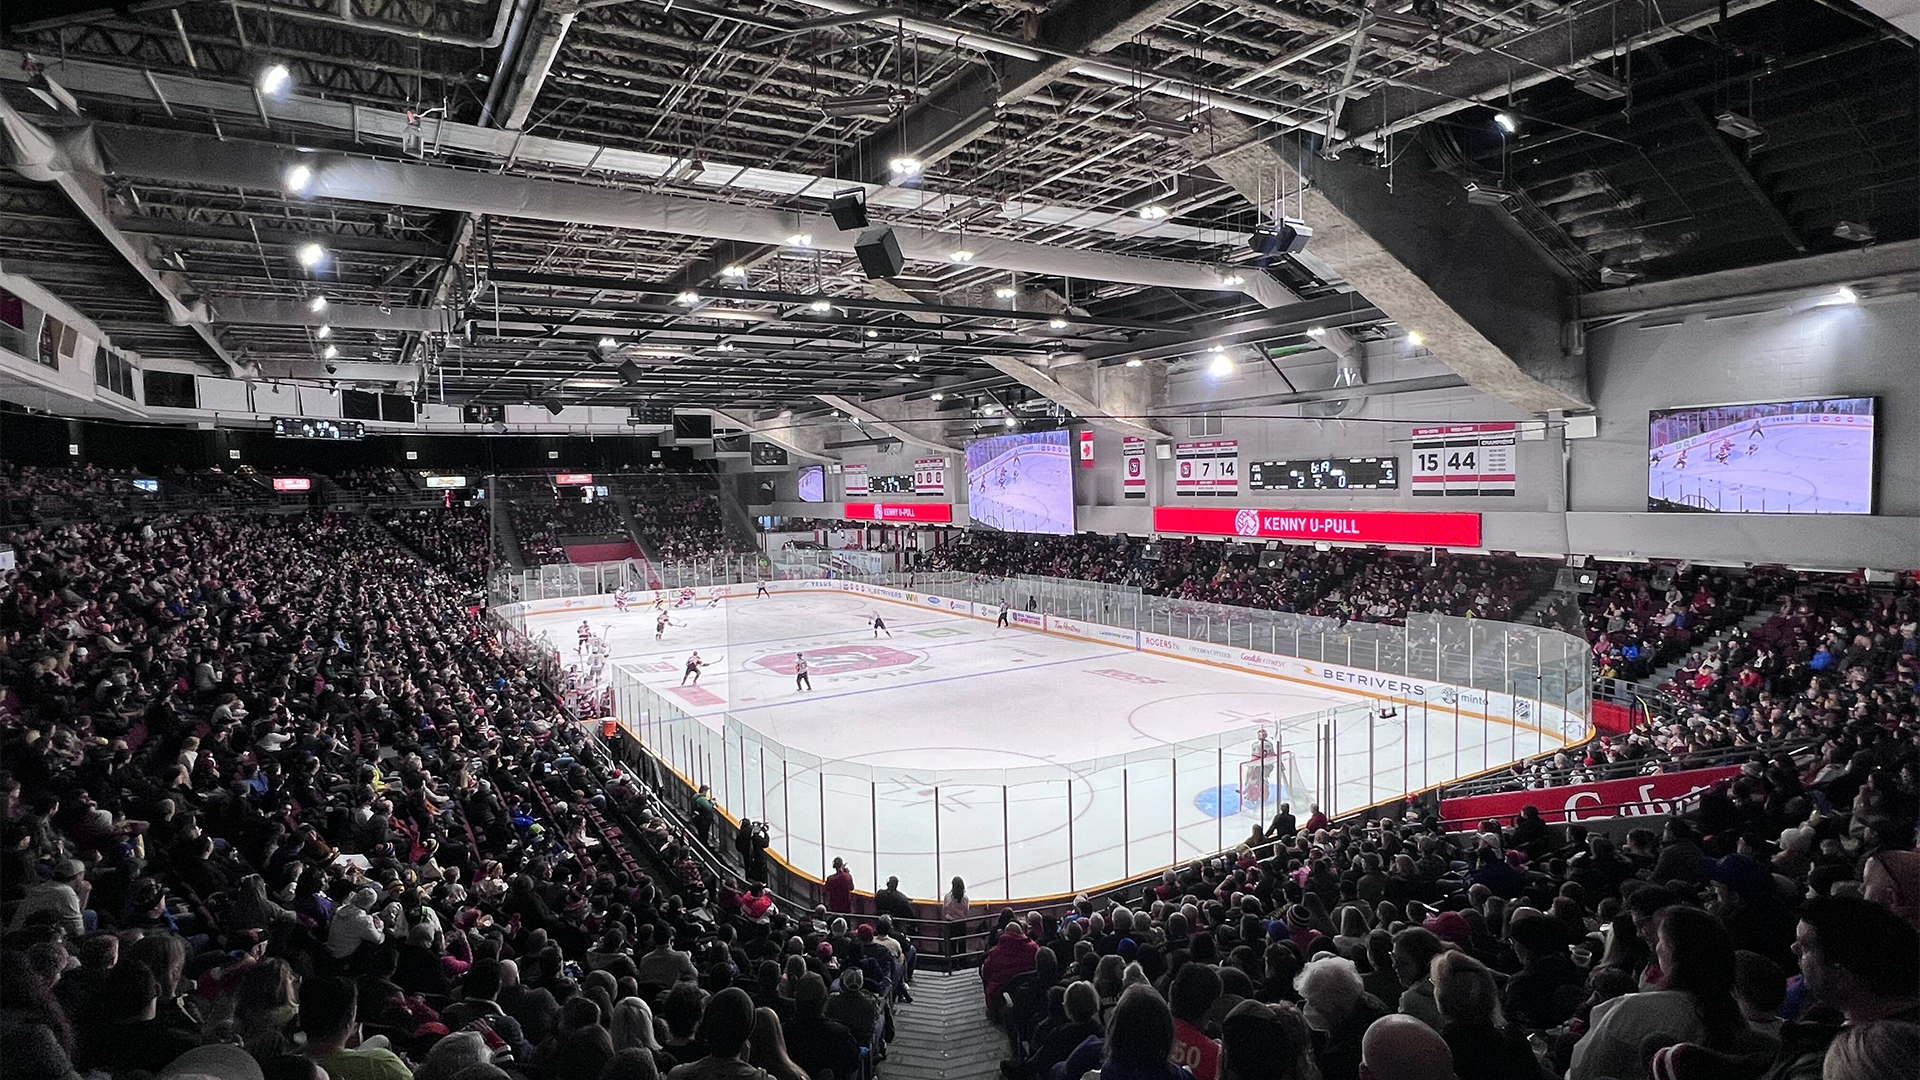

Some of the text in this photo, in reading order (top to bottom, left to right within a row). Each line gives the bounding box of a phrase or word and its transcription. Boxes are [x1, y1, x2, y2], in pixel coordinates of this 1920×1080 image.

[1418, 453, 1439, 472] 15
[1447, 451, 1476, 470] 44
[1202, 462, 1210, 477] 7
[1220, 461, 1235, 476] 14
[1297, 476, 1305, 488] 2
[1338, 475, 1346, 488] 0
[883, 508, 915, 517] KENNY U-PULL
[1264, 516, 1360, 534] KENNY U-PULL
[1145, 636, 1173, 649] ROGERS
[1240, 652, 1262, 664] GoodLife
[1262, 659, 1286, 667] FITNESS
[1323, 669, 1425, 696] BETRIVERS
